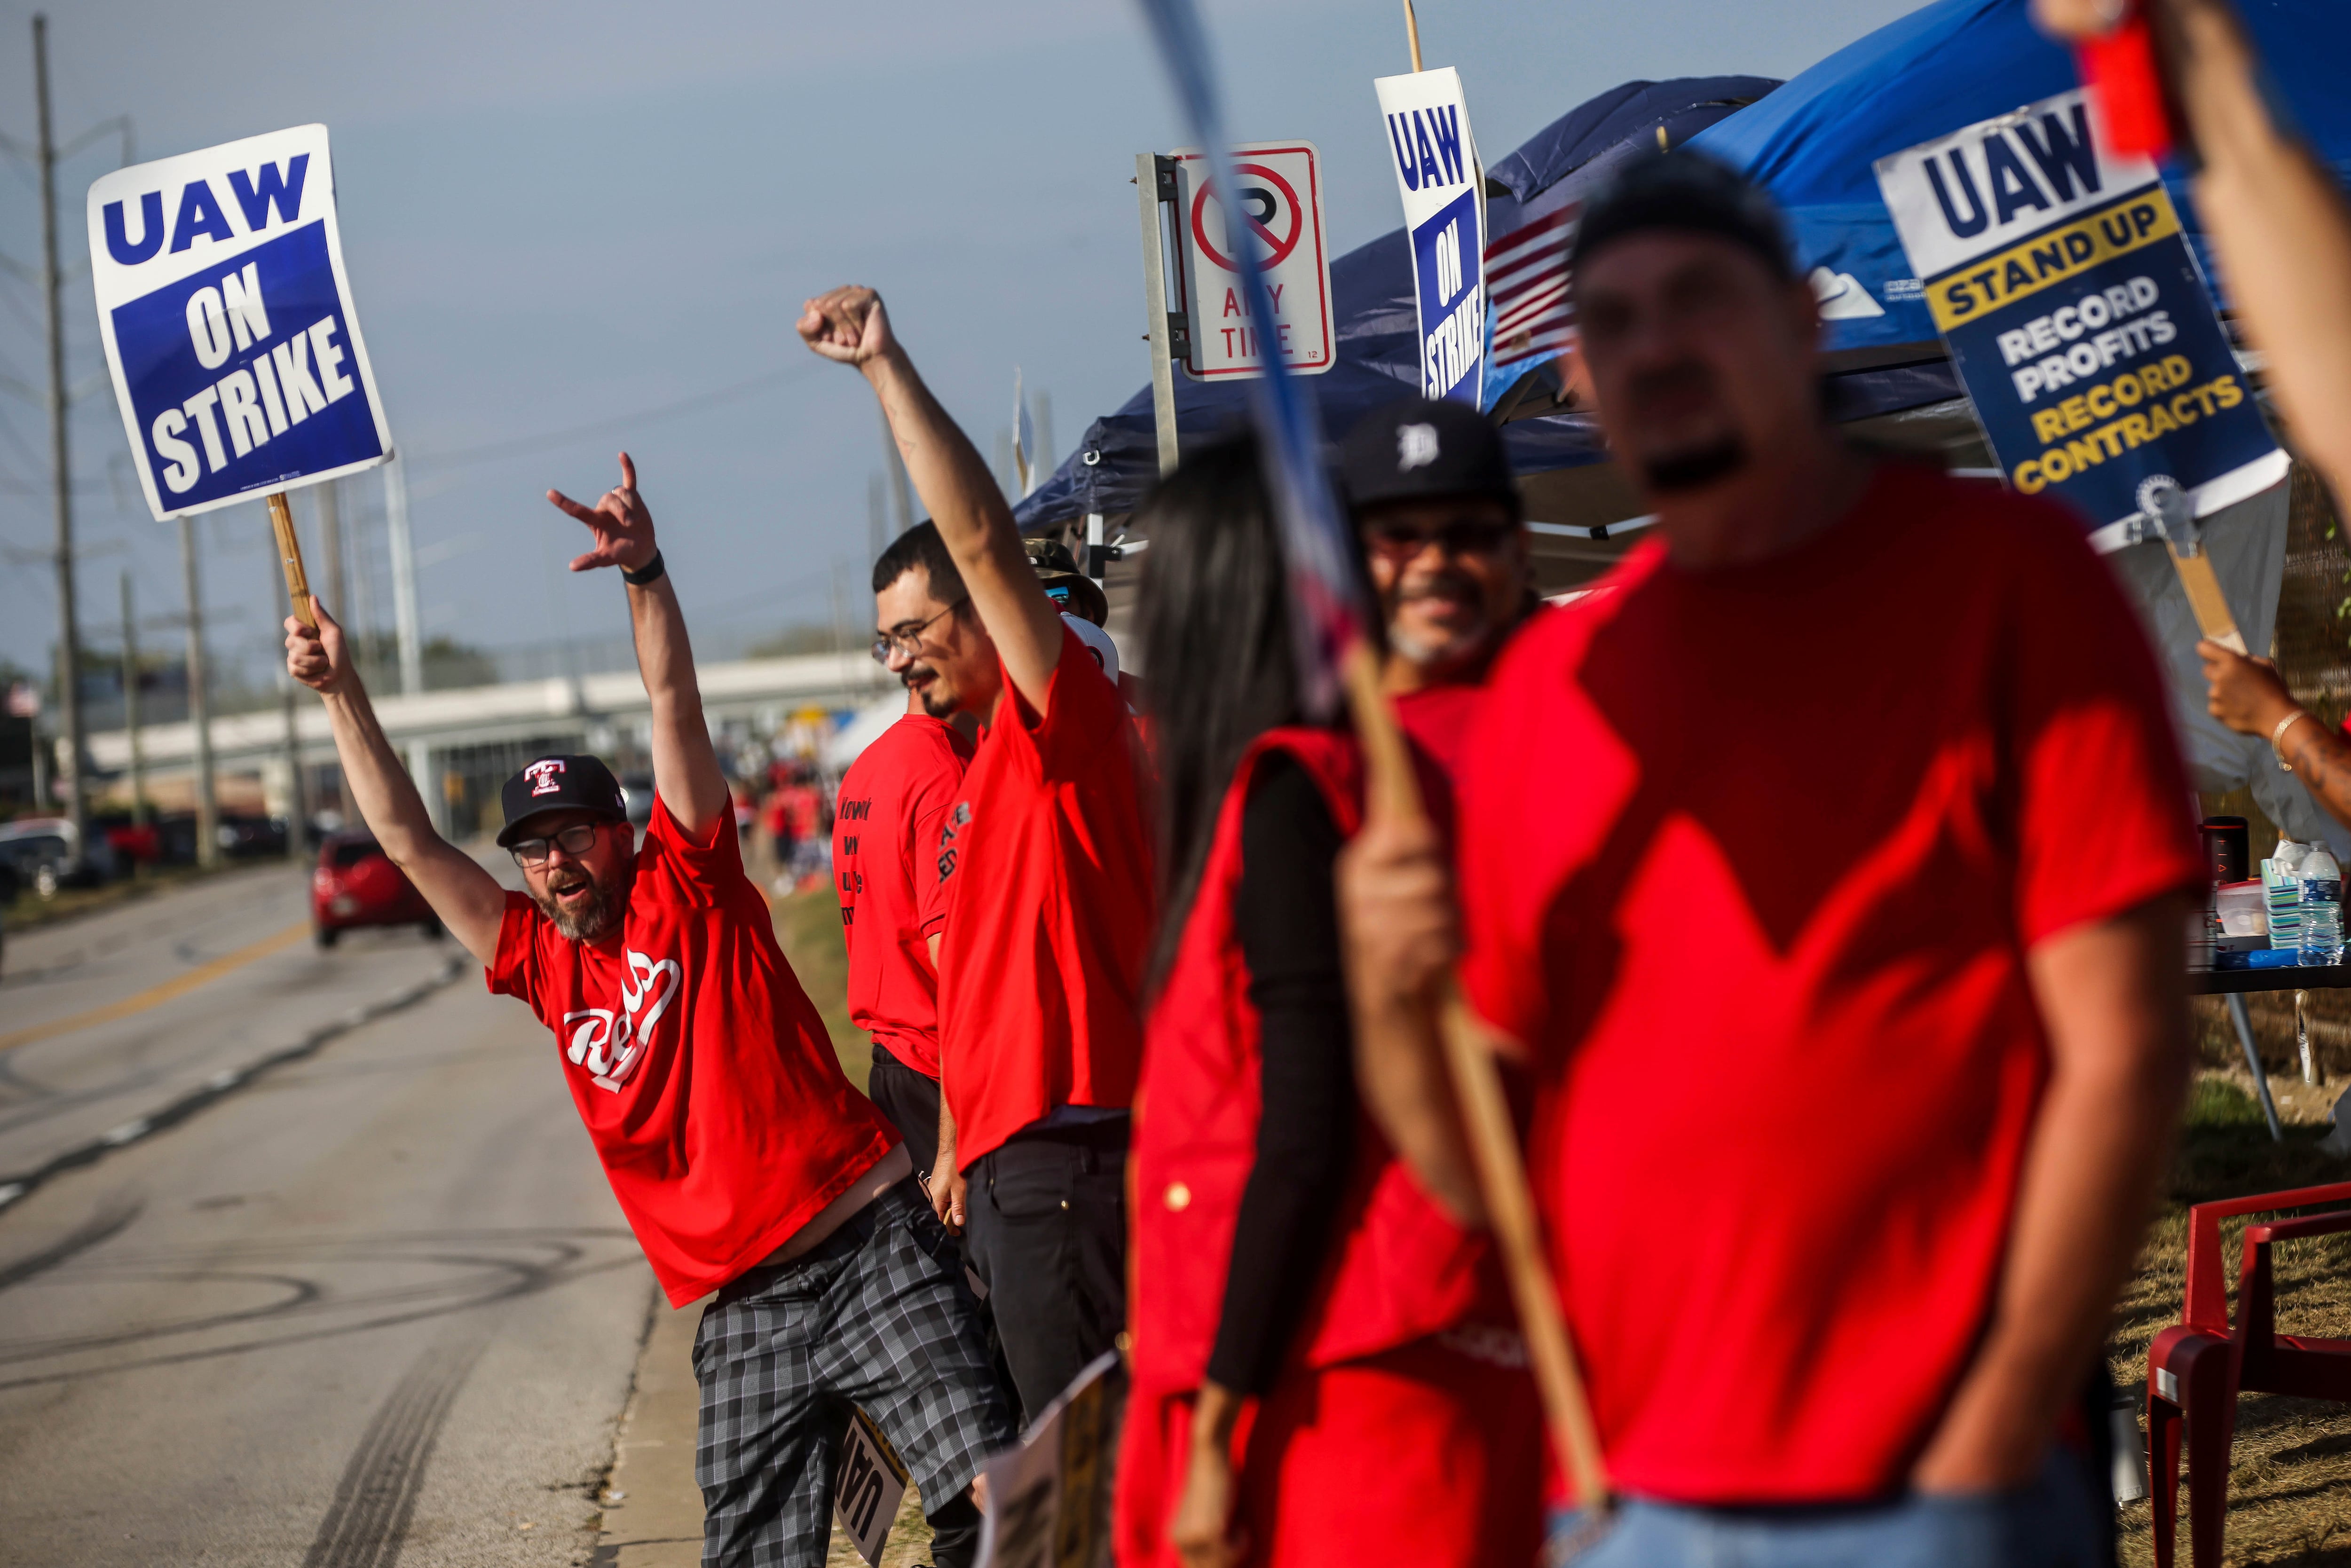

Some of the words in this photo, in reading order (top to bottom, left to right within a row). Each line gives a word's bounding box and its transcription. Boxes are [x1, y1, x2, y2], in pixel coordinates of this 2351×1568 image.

[1388, 103, 1465, 191] UAW
[1924, 102, 2103, 238] UAW
[103, 152, 310, 265] UAW
[1436, 217, 1462, 307] ON
[1946, 230, 2093, 316] STAND
[2100, 203, 2157, 247] UP
[186, 261, 272, 370] ON
[1426, 284, 1479, 401] STRIKE
[1996, 276, 2160, 367] RECORD
[2011, 310, 2177, 404] PROFITS
[152, 315, 355, 494] STRIKE
[2012, 375, 2244, 495] CONTRACTS
[2030, 355, 2193, 445] RECORD
